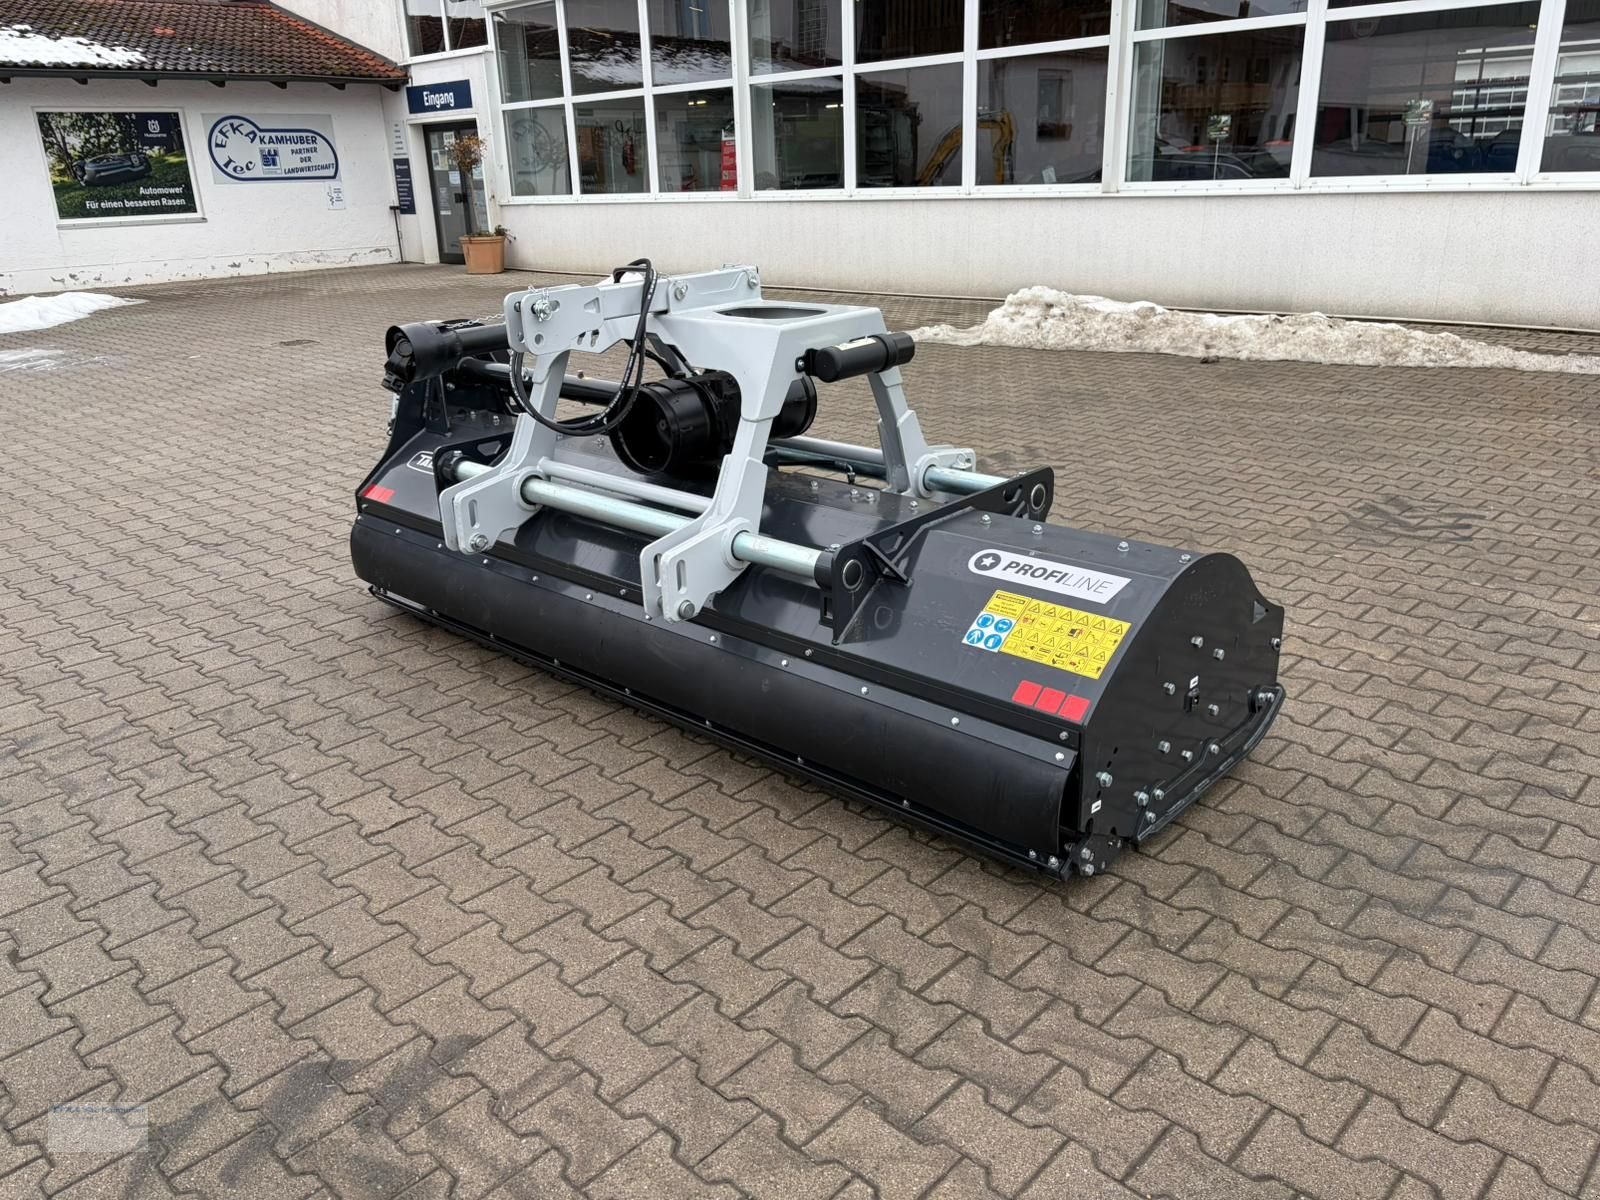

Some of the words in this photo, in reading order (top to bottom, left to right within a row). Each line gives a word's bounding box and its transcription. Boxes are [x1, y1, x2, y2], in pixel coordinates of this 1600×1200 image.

[423, 91, 455, 108] Eingang
[215, 122, 258, 149] EFKA
[259, 135, 318, 146] KAMHUBER
[291, 146, 318, 156] PARTNER
[223, 155, 256, 175] Tec
[300, 156, 312, 164] DER
[284, 162, 335, 175] LANDWIRTSCHAFT
[86, 201, 99, 210] Für
[100, 200, 124, 209] einen
[124, 199, 161, 208] besseren
[162, 197, 186, 206] Rasen
[1002, 560, 1113, 594] PROFILINE
